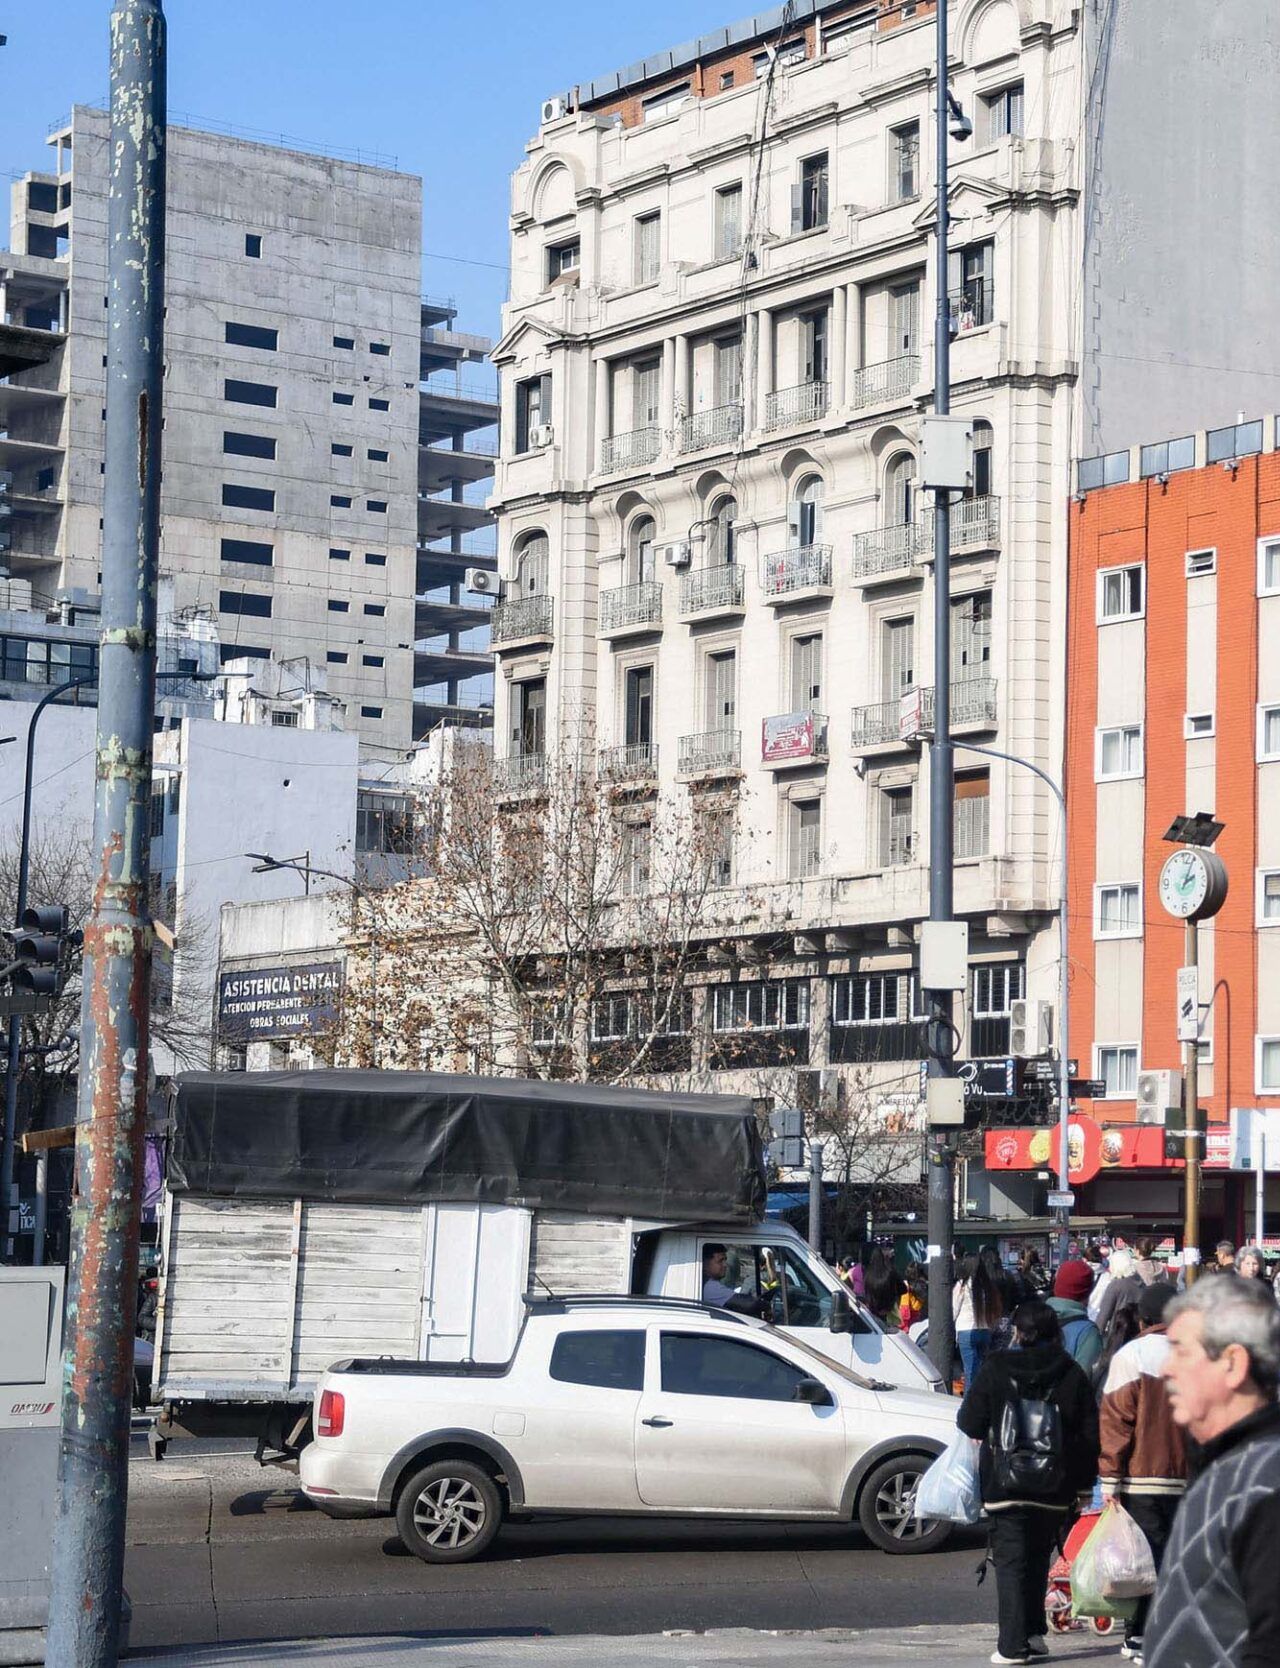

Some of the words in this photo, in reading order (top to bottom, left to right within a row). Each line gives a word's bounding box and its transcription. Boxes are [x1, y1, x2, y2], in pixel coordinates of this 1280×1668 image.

[224, 977, 290, 997] ASISTENCIA
[293, 972, 339, 992] DENTAL
[223, 1002, 256, 1014] ATENCION
[250, 1017, 273, 1028] OBRAS
[276, 1014, 309, 1026] SOCIALES
